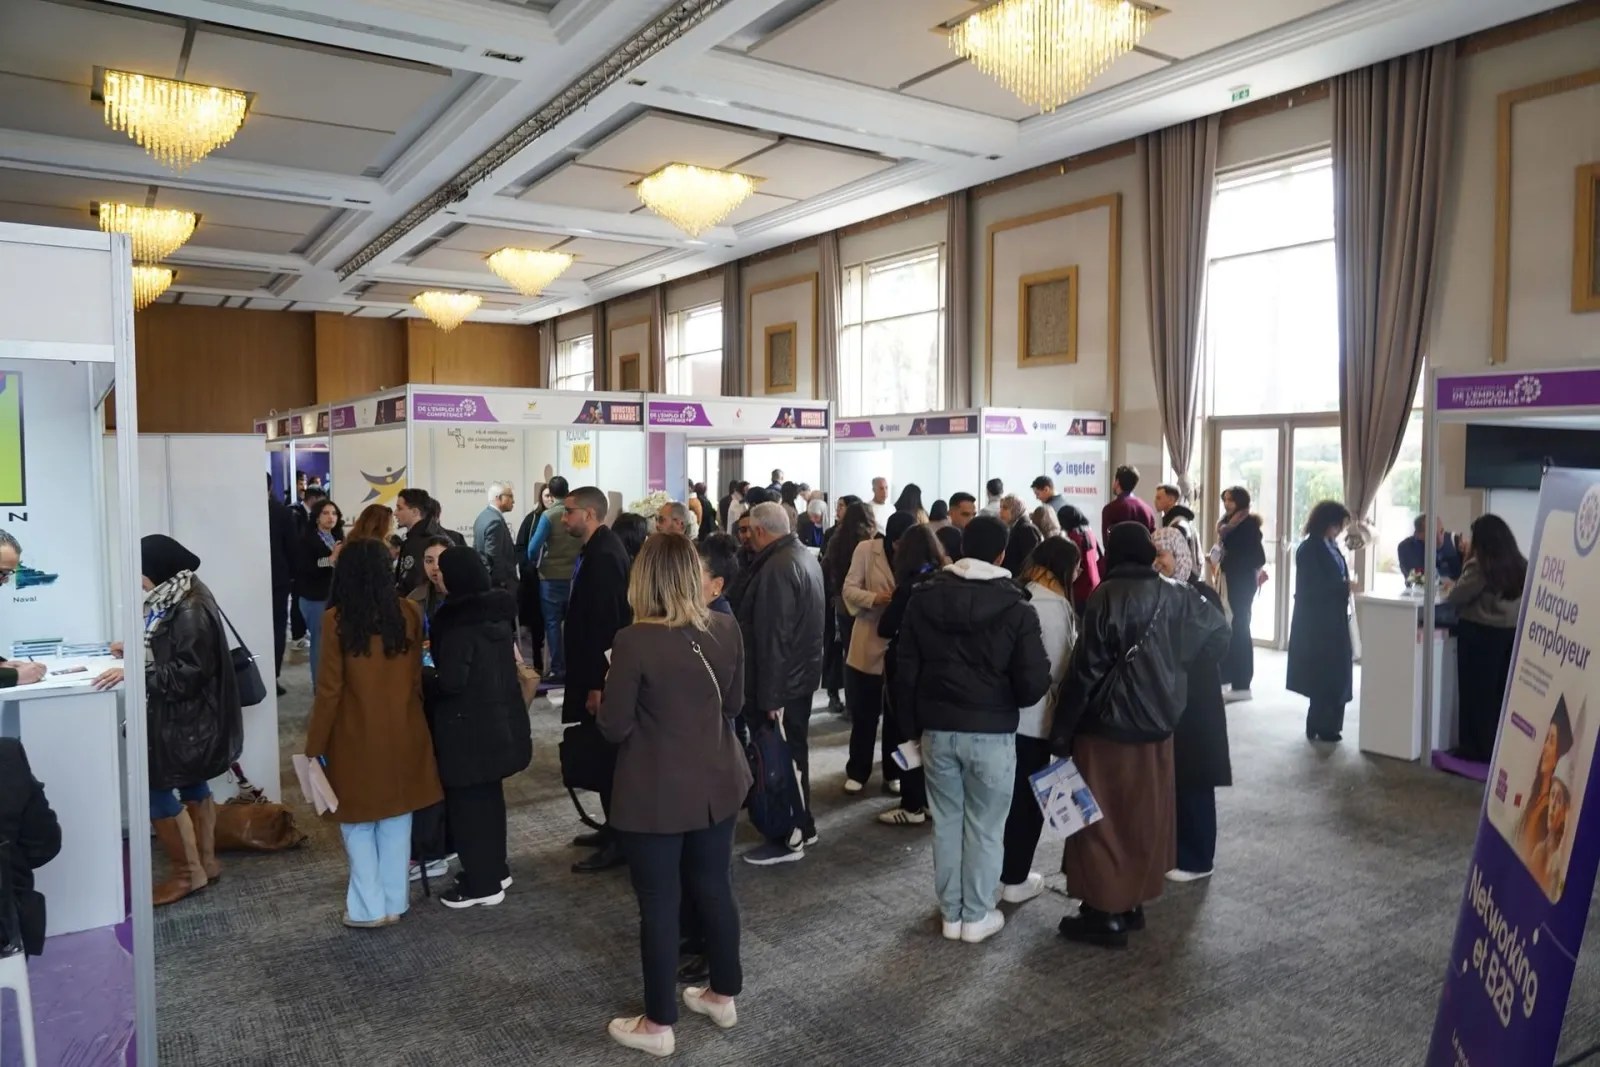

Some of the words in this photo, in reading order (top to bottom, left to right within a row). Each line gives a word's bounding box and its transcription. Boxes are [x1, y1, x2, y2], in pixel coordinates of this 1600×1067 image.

[1066, 461, 1096, 476] ingelec
[1075, 486, 1098, 495] VALEURS
[1541, 555, 1566, 591] DRH,
[1534, 583, 1579, 625] Marque
[1528, 619, 1591, 671] employeur
[1468, 863, 1538, 1018] Networking
[1473, 936, 1489, 980] et
[1485, 949, 1515, 1028] B2B
